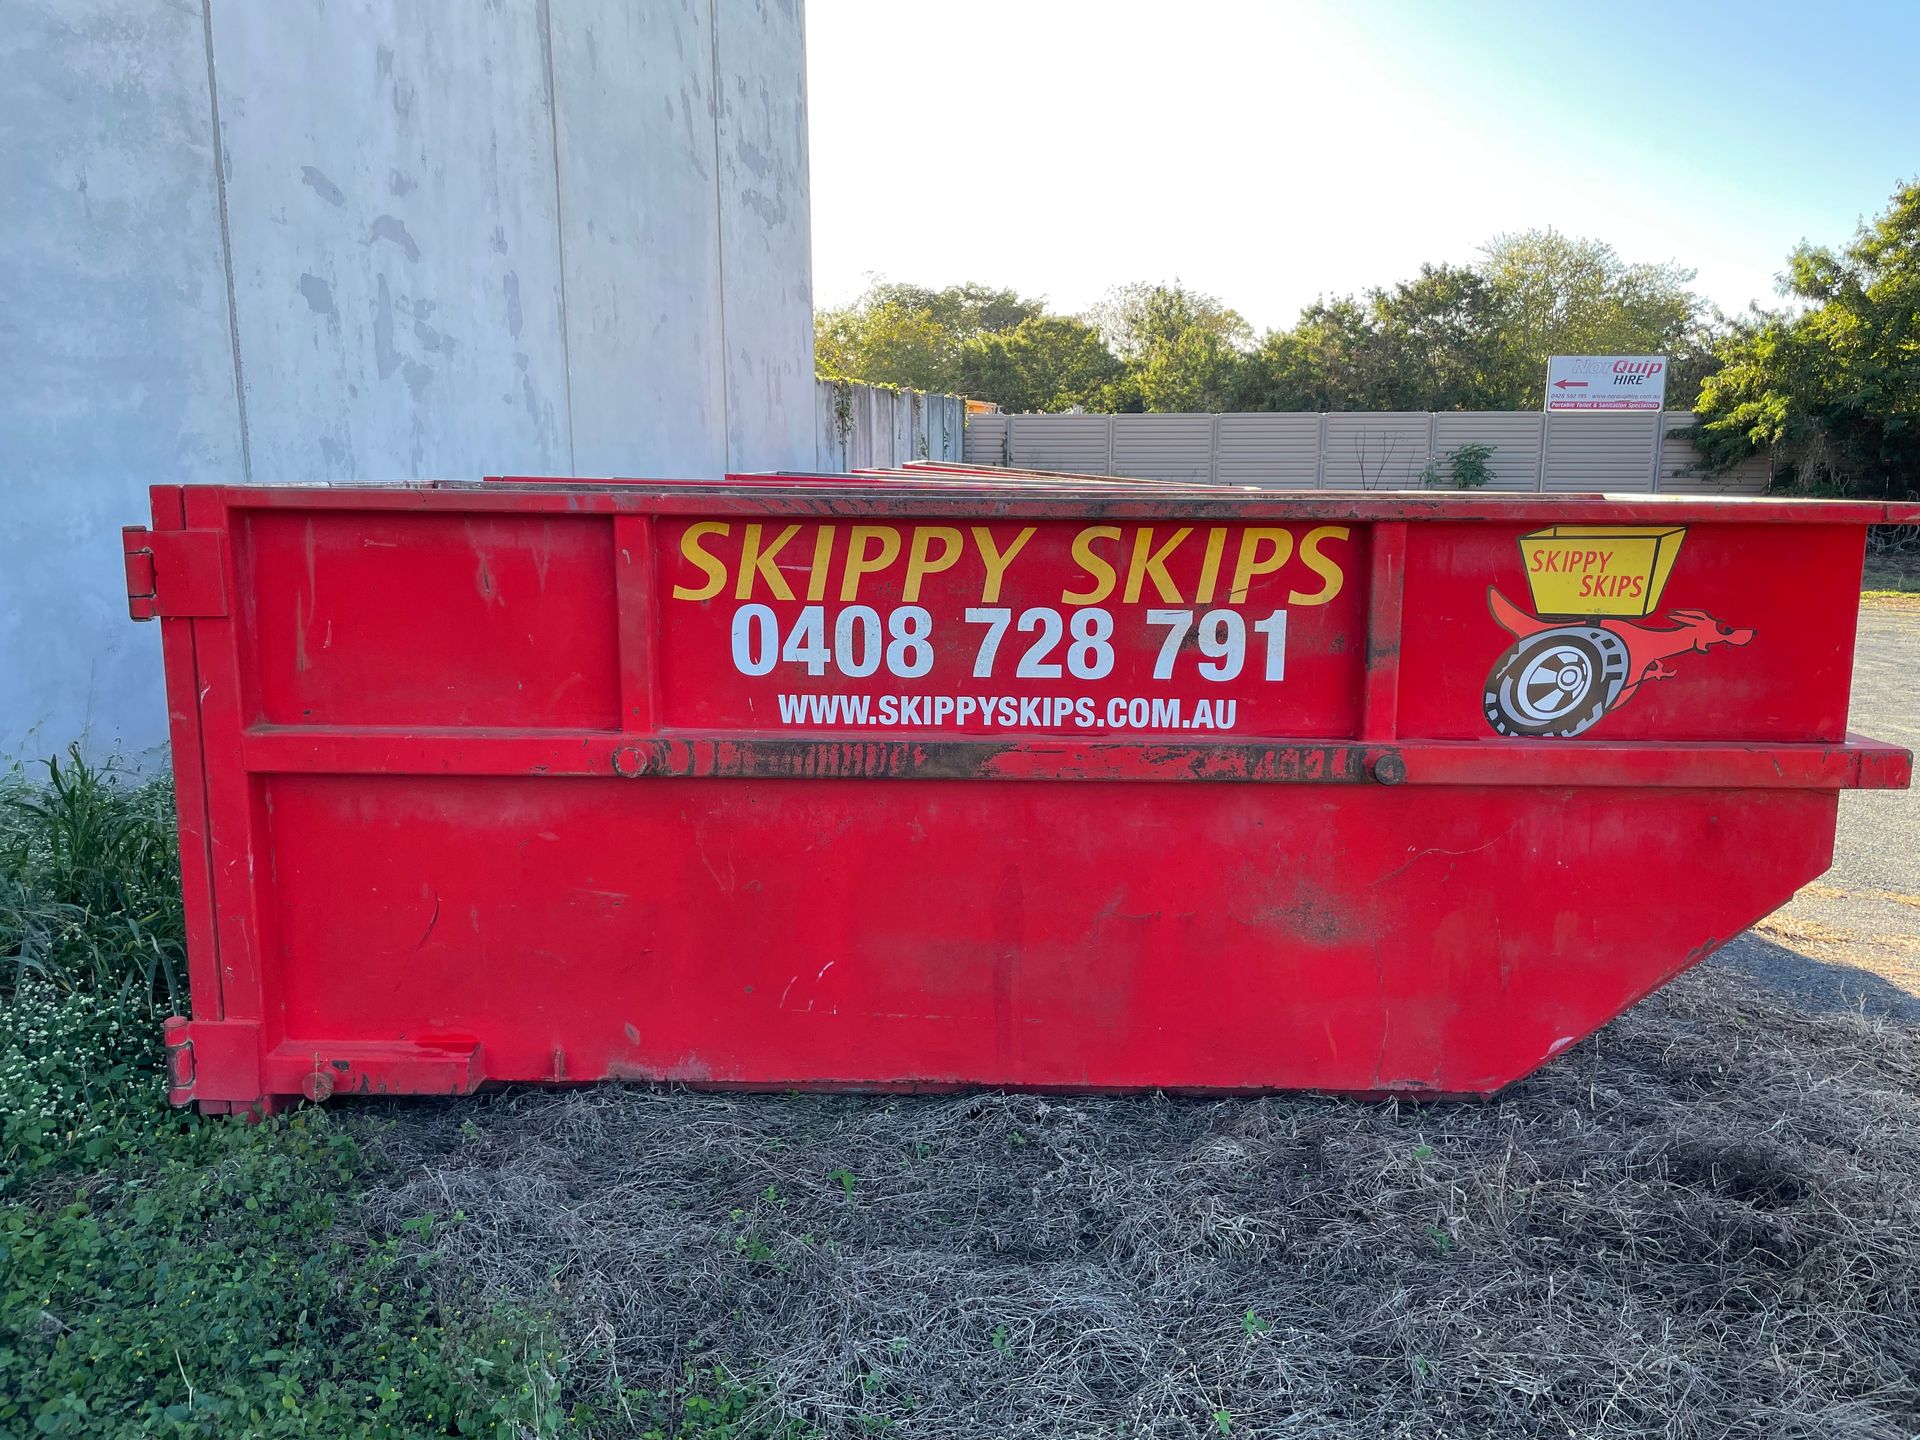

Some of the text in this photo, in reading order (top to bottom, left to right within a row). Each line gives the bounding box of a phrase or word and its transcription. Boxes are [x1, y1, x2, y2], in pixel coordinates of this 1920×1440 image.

[1572, 358, 1662, 378] NorQuip
[1613, 375, 1645, 385] HIRE
[672, 522, 1350, 605] SKIPPY SKIPS
[1531, 550, 1613, 573] SKIPPY
[1579, 575, 1644, 598] SKIPS
[731, 604, 1286, 681] 0408 728 791
[778, 693, 1236, 729] WWW.SKIPPYSKIPS.COM.AU
